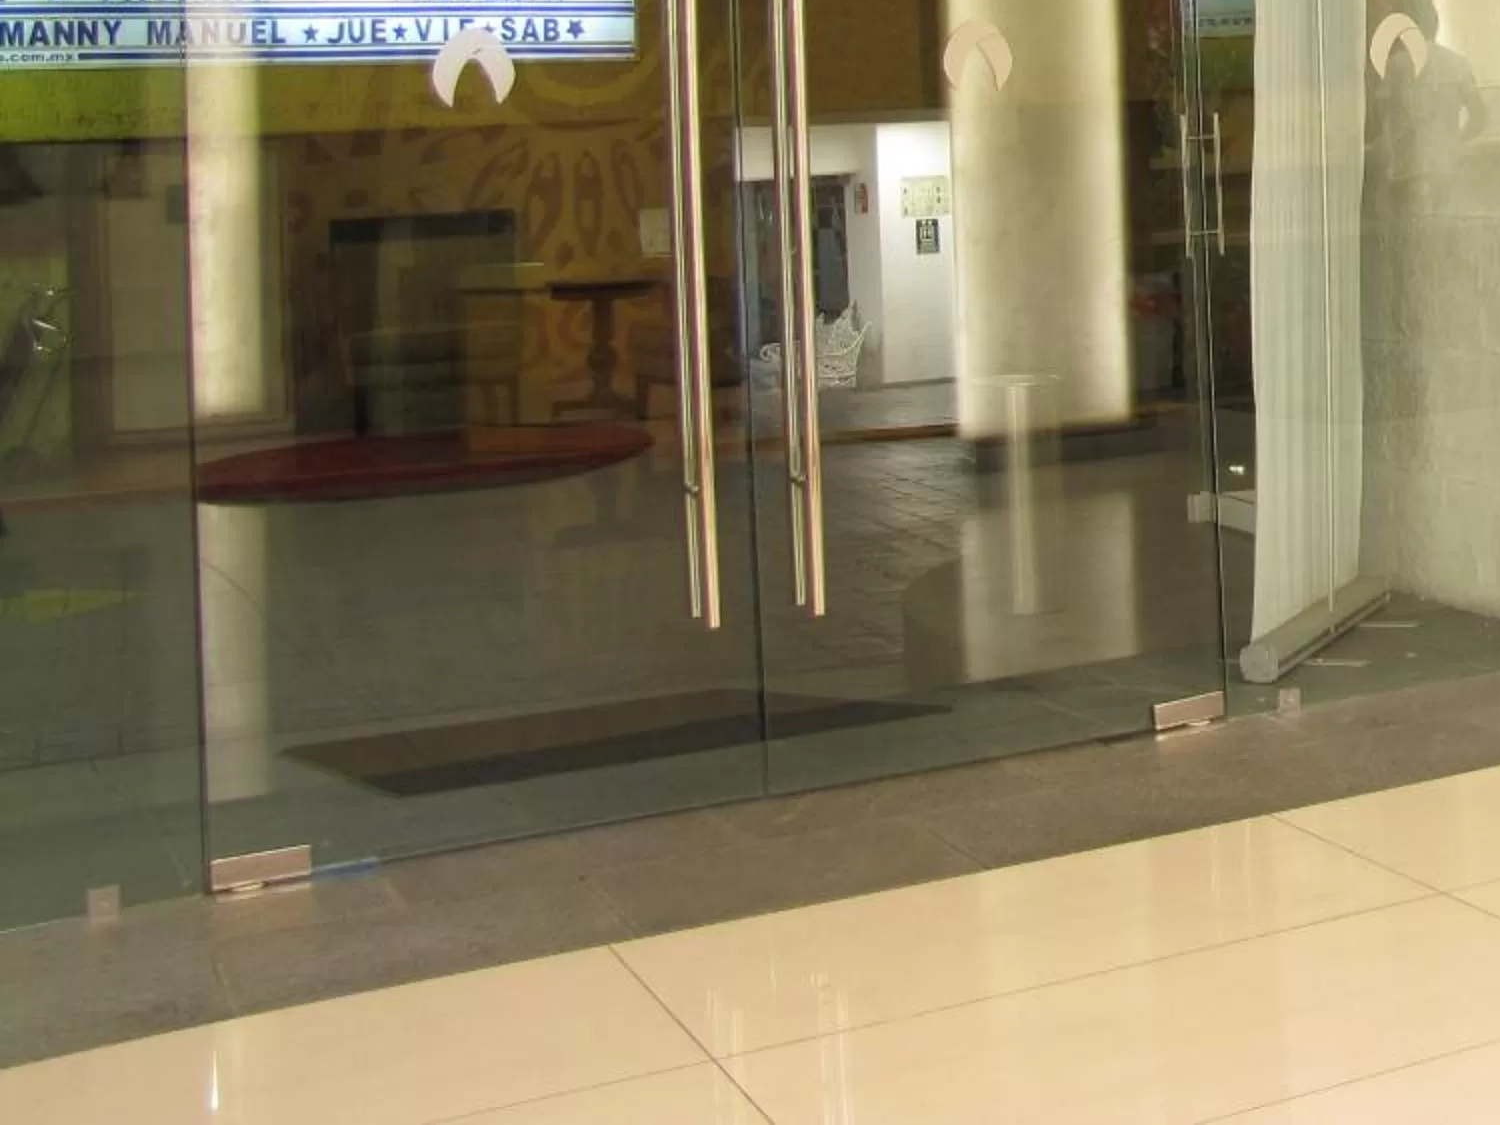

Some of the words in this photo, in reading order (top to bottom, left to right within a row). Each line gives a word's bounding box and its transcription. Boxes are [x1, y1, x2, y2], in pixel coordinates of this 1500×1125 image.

[0, 20, 122, 46] MANNY
[147, 20, 287, 46] MANUEL
[501, 18, 561, 42] SAB
